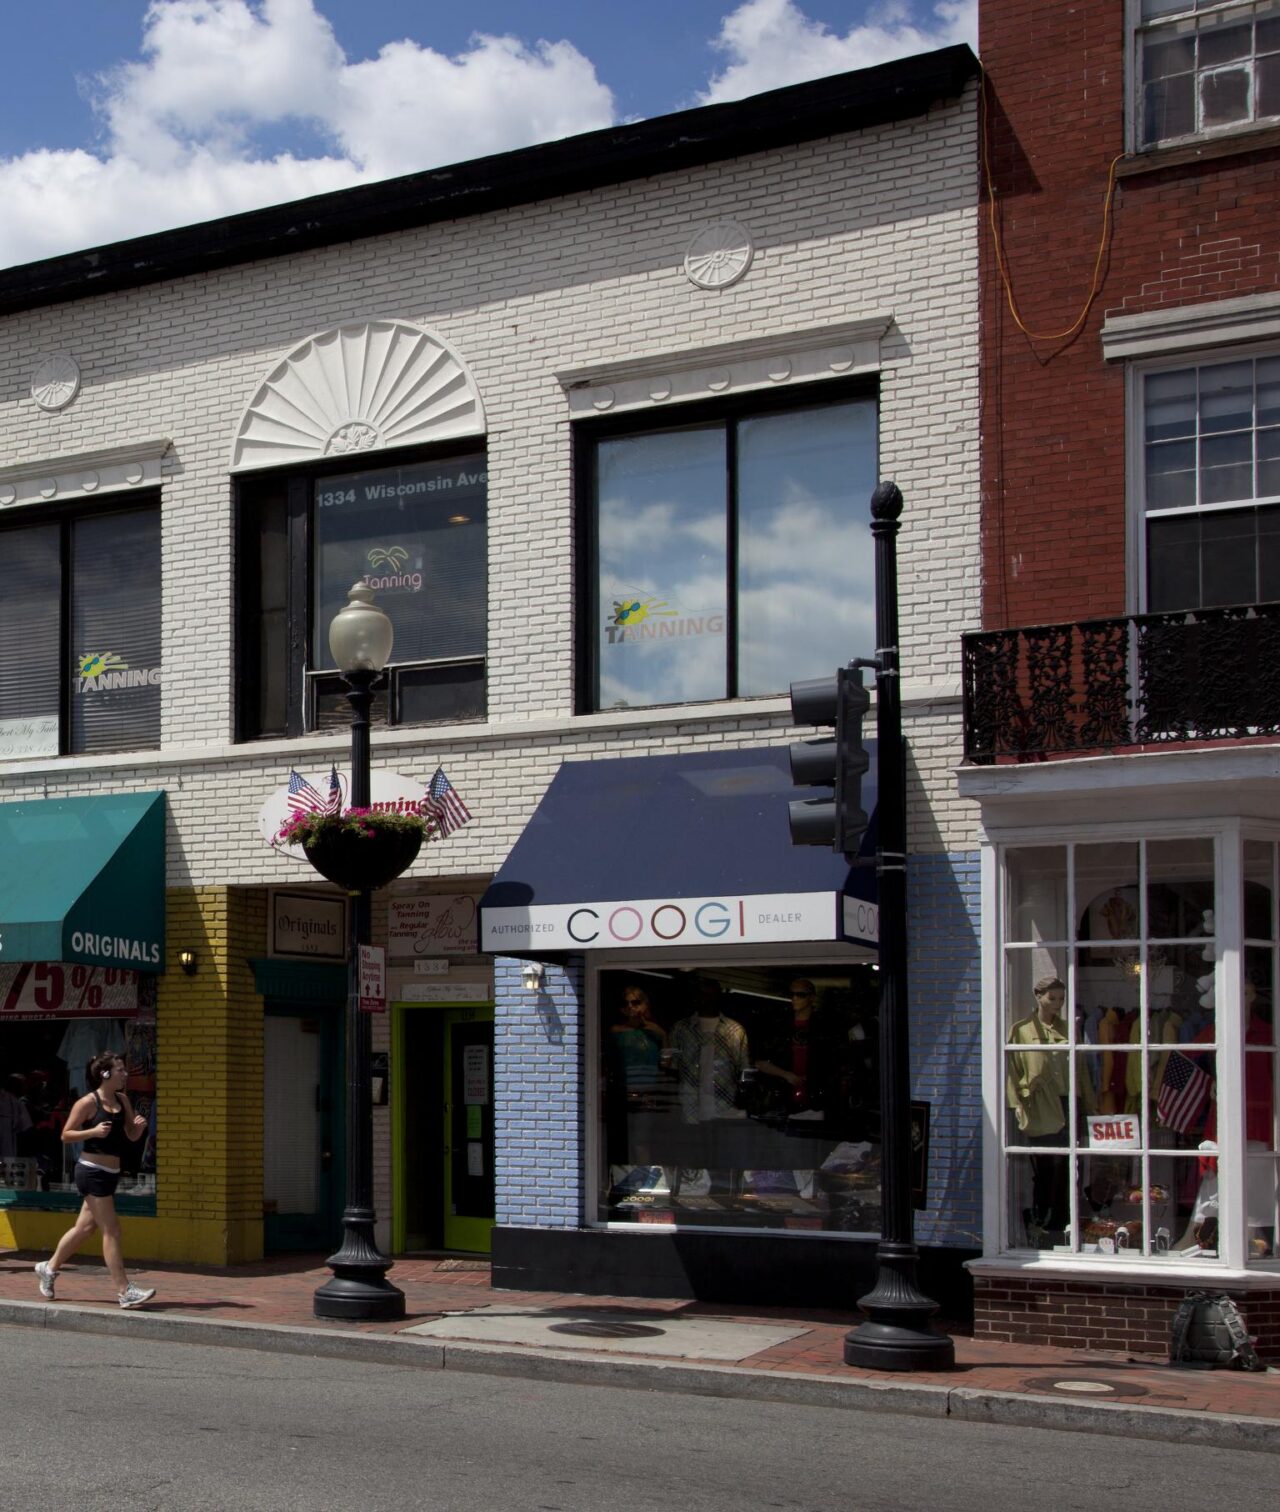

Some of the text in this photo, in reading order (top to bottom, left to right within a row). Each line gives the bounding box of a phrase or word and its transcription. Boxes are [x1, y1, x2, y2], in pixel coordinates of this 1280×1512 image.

[317, 472, 487, 507] 1334 Wisconsin Ave
[363, 572, 422, 591] Tanning
[605, 616, 723, 644] TANNING
[73, 668, 161, 693] TANNING
[392, 901, 430, 911] Spray On
[278, 915, 337, 940] Originals
[400, 921, 429, 929] Regular
[491, 900, 801, 942] AUTHORIZED COOGI DEALER
[389, 931, 418, 939] Tanning
[72, 932, 160, 963] ORIGINALS
[362, 950, 371, 959] No
[1093, 1121, 1134, 1141] SALE
